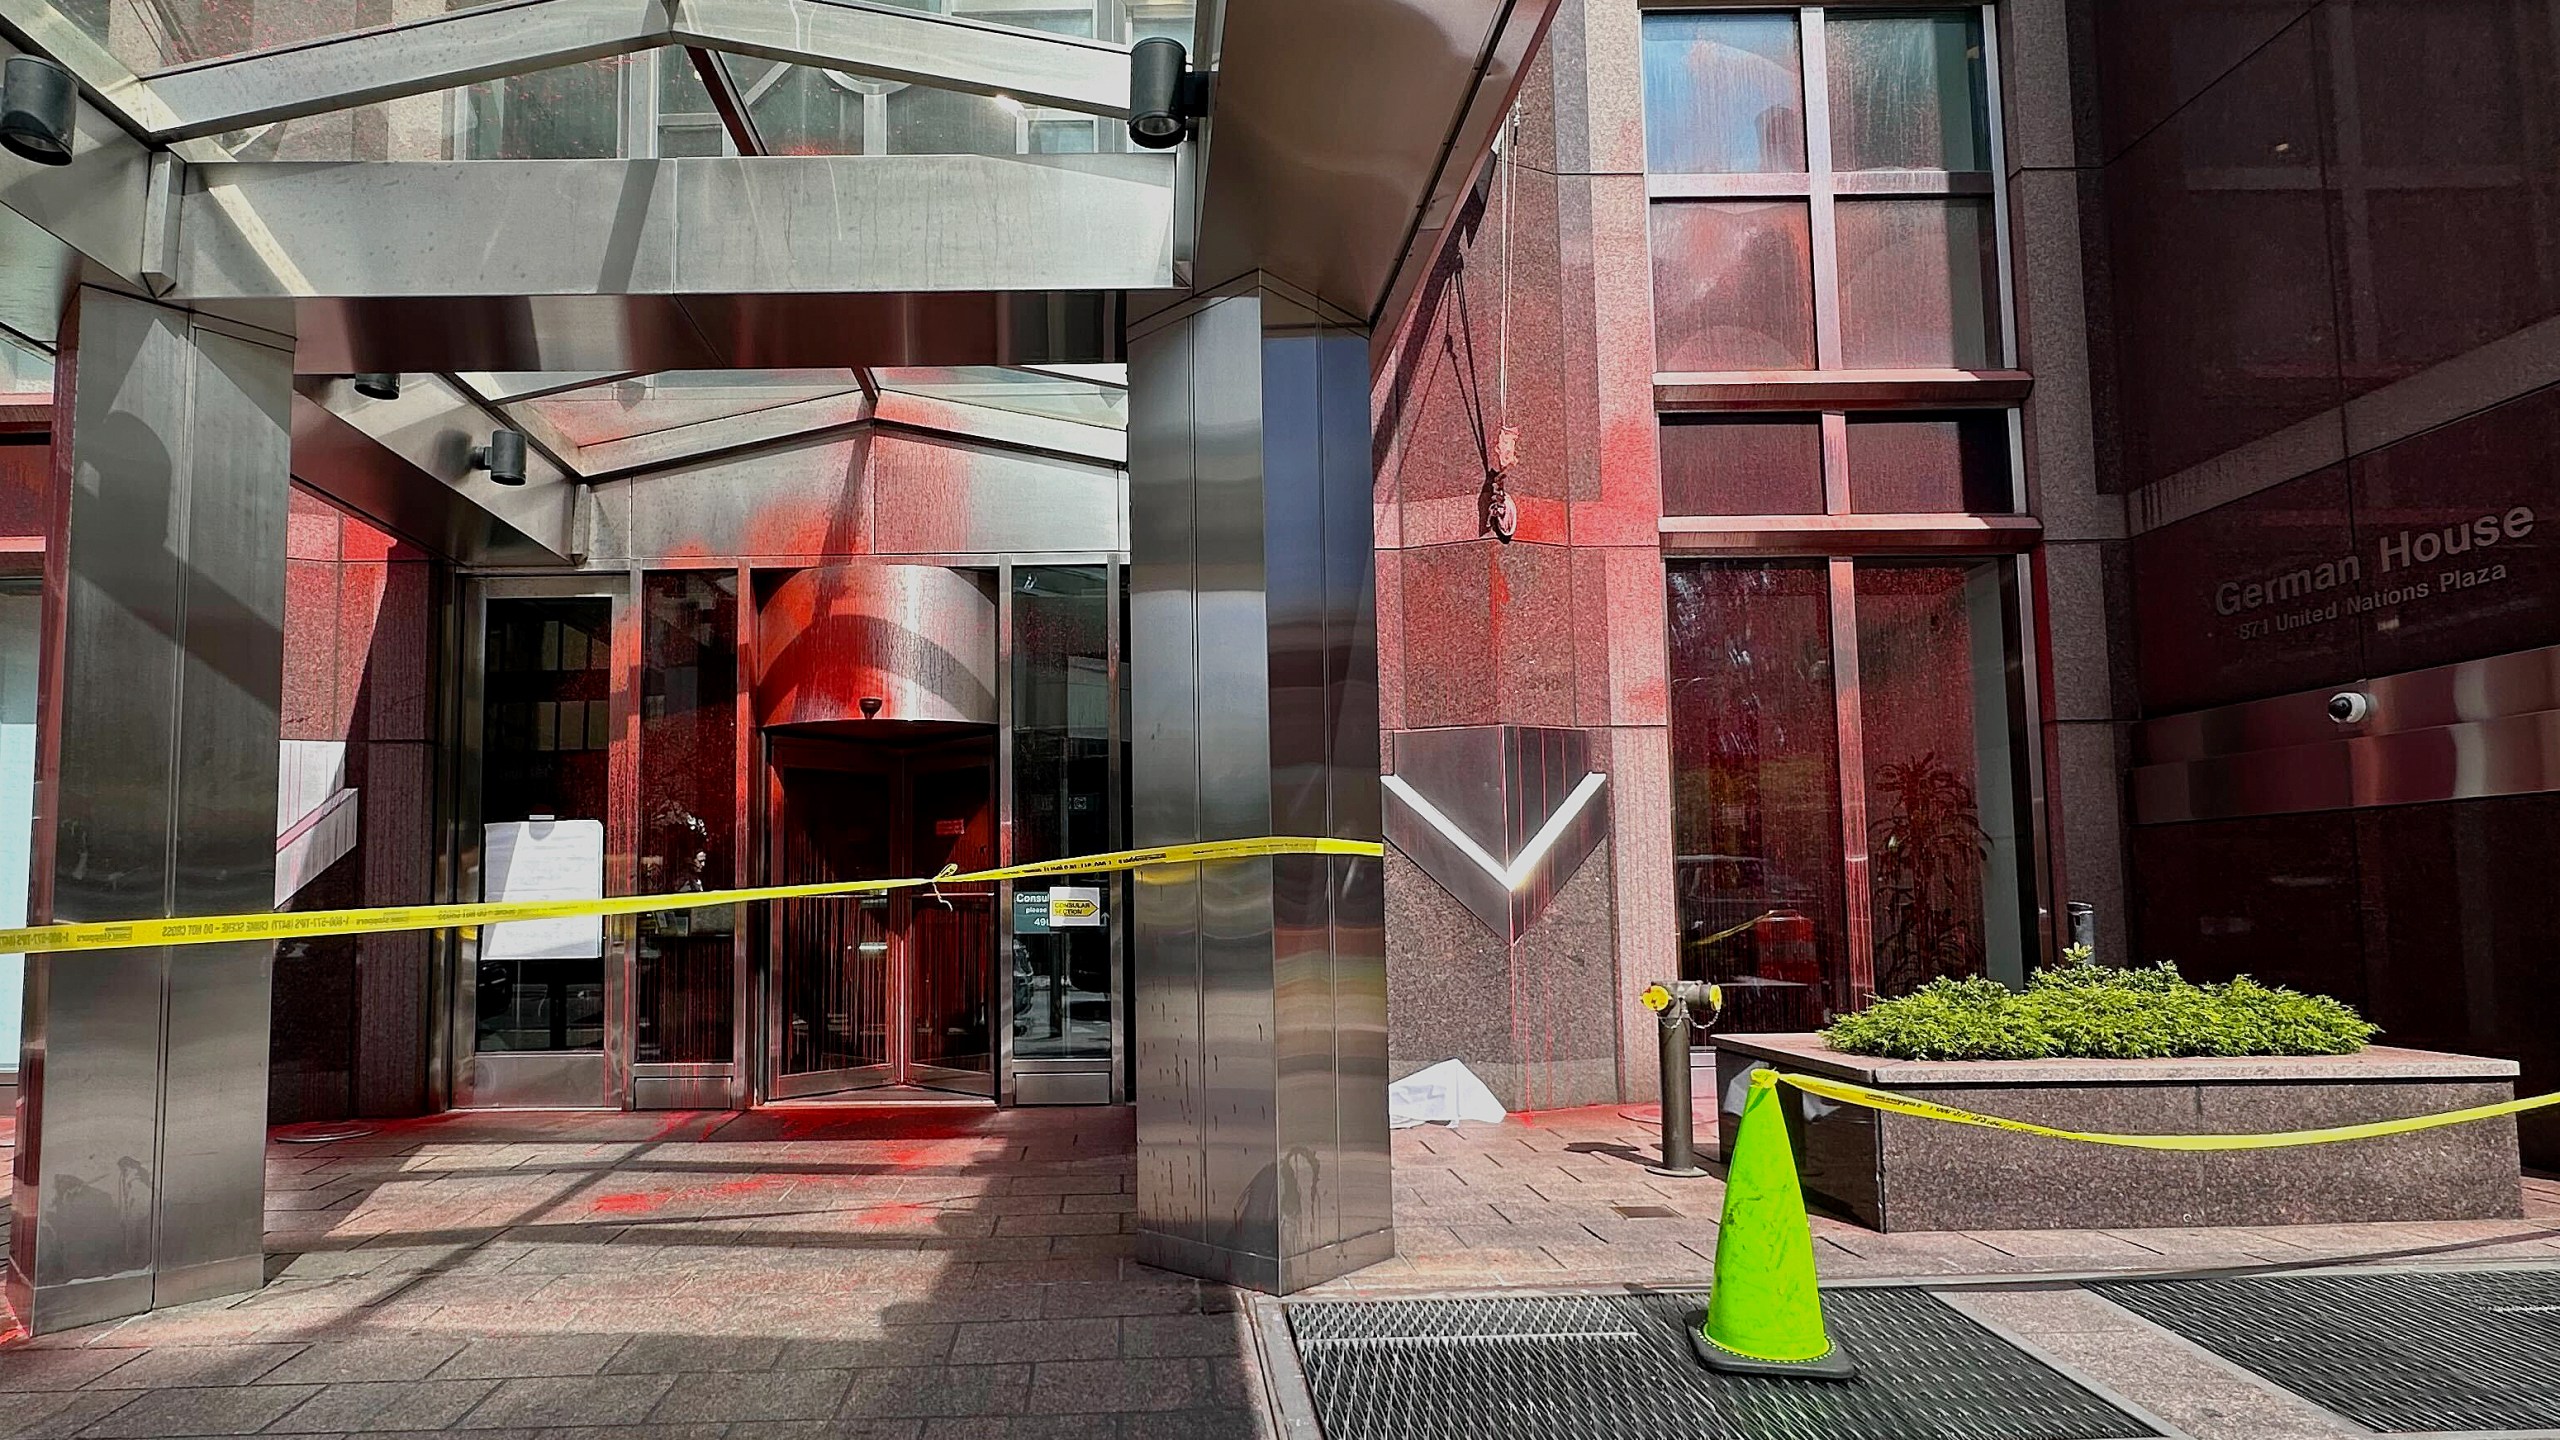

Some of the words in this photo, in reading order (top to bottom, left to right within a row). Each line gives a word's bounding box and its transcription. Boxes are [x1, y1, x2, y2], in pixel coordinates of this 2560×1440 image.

[2214, 553, 2361, 616] German
[2379, 505, 2535, 573] House
[2276, 600, 2339, 631] United
[2347, 581, 2430, 614] Nations
[2439, 564, 2508, 593] Plaza
